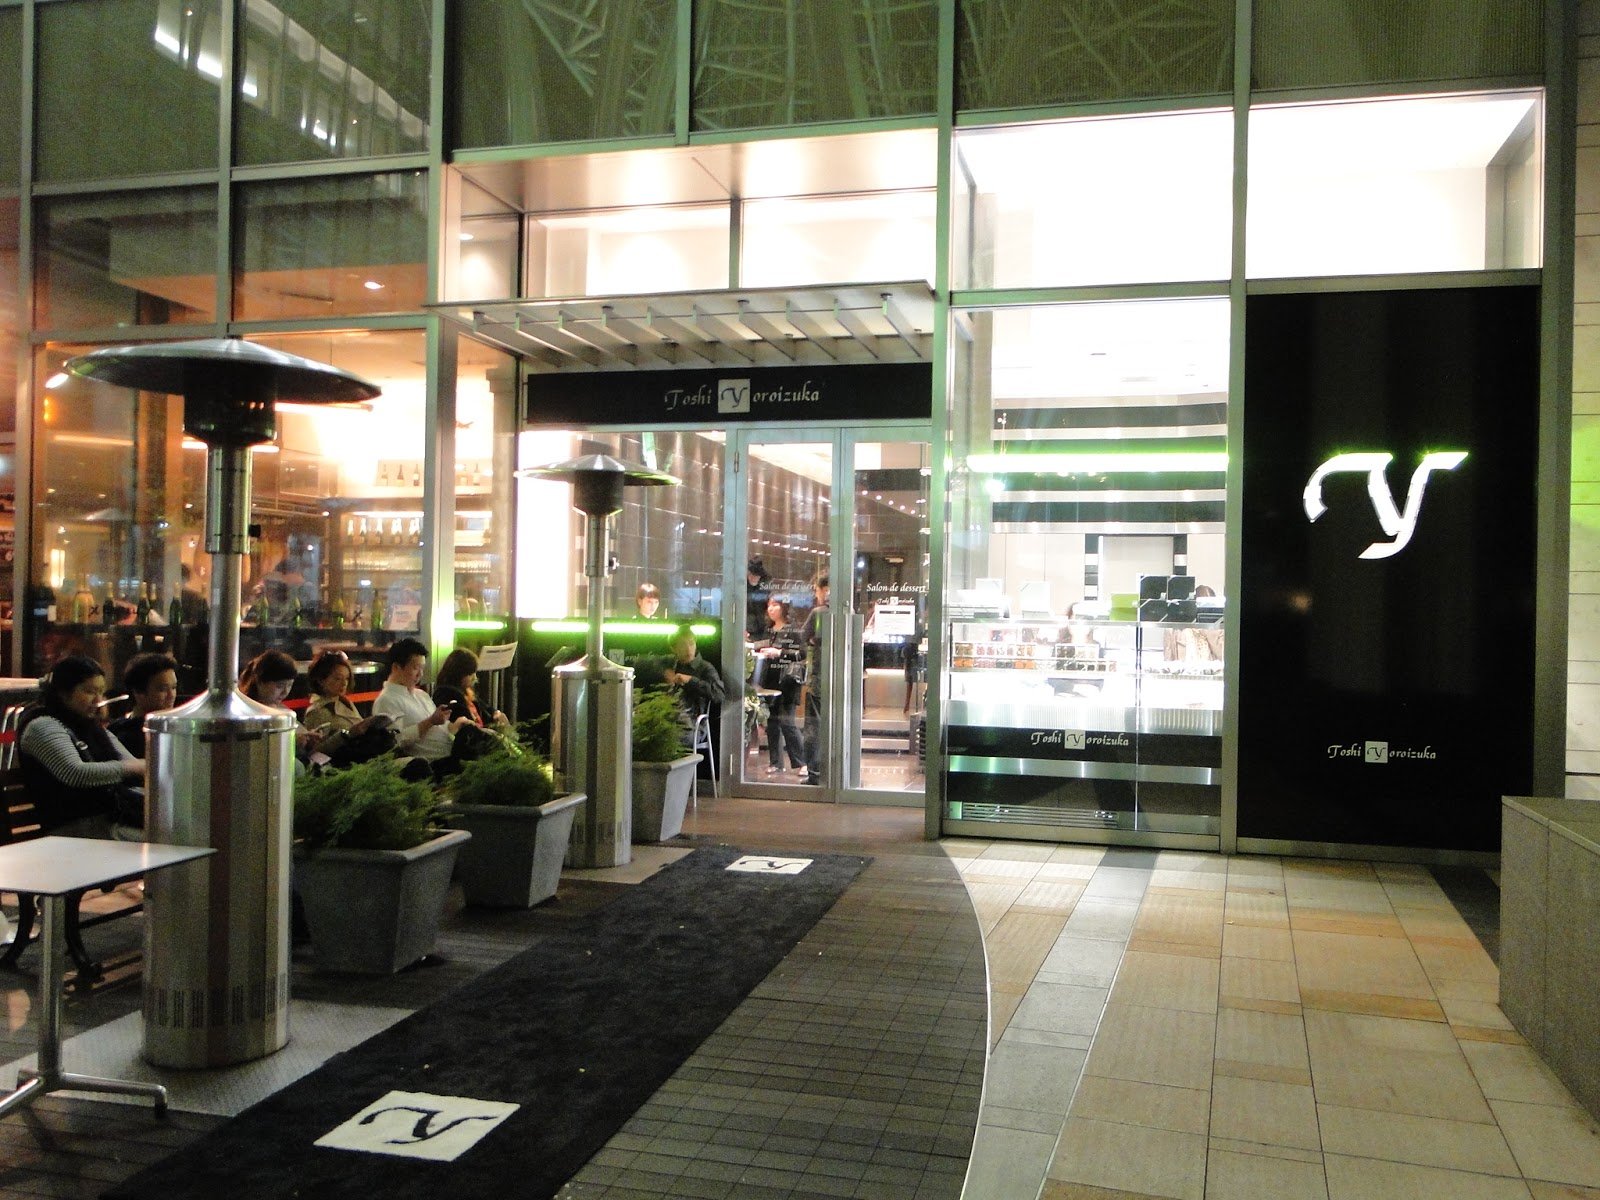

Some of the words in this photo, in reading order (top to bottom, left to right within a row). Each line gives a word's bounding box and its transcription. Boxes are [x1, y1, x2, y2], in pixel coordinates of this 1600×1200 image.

[664, 384, 712, 411] Toshi
[759, 580, 780, 590] Salon
[866, 582, 888, 592] Salon
[889, 582, 899, 592] de
[900, 582, 927, 593] dessert
[1031, 730, 1062, 746] Toshi
[1327, 743, 1362, 759] Toshi
